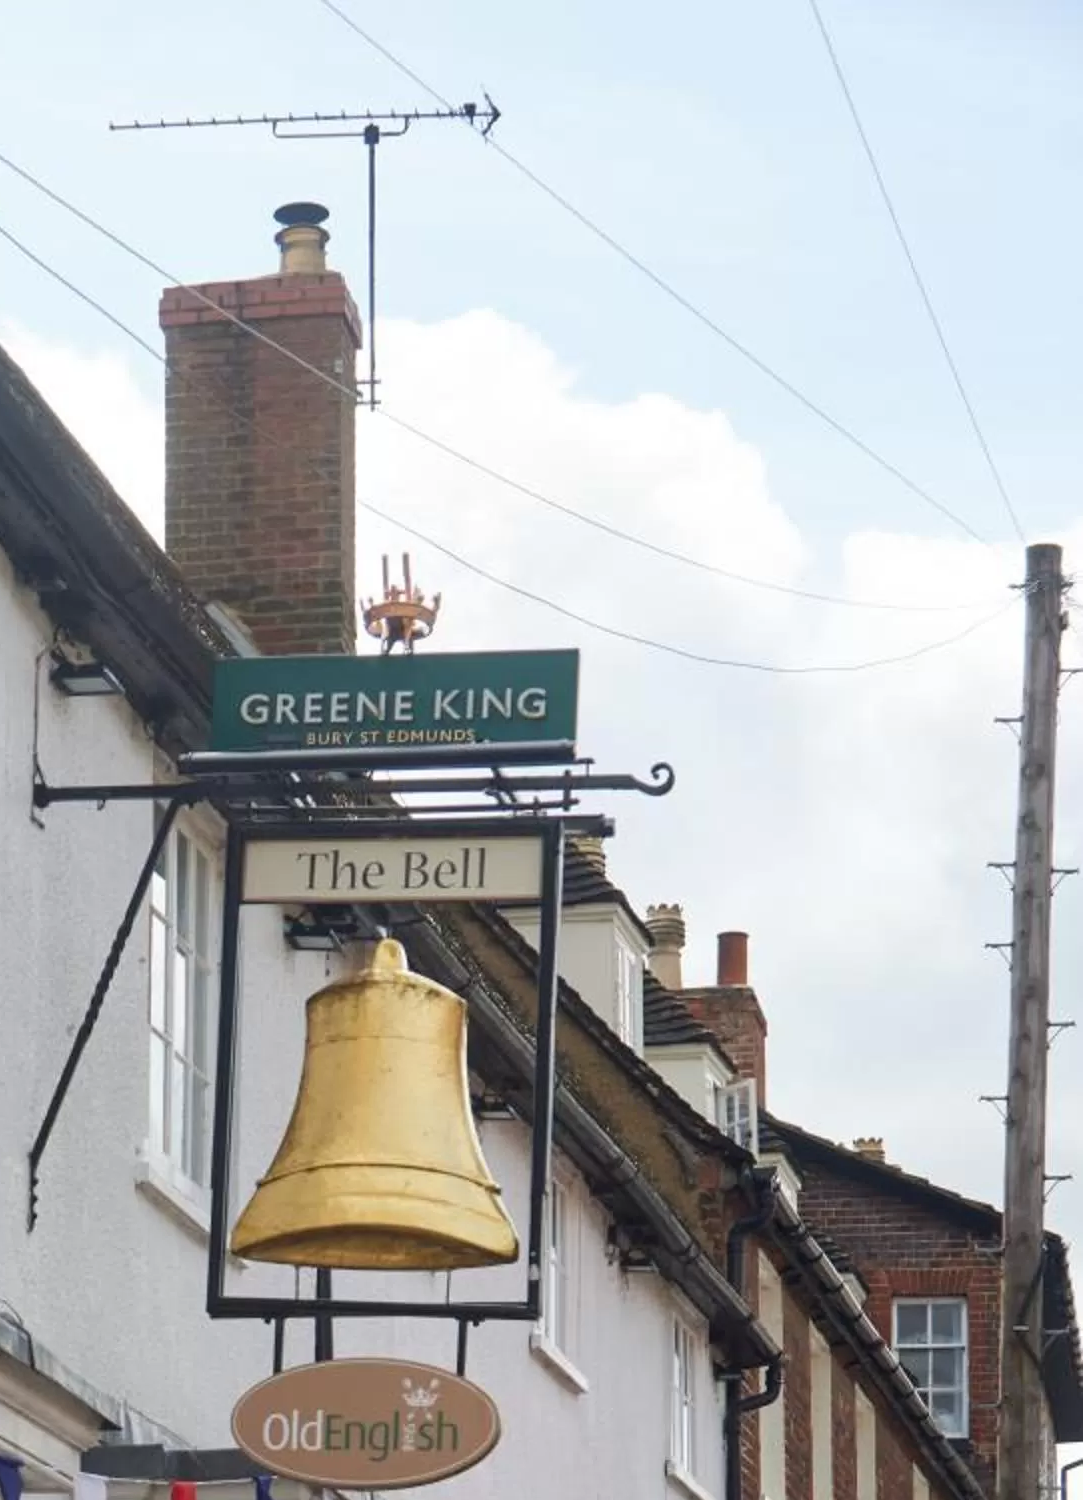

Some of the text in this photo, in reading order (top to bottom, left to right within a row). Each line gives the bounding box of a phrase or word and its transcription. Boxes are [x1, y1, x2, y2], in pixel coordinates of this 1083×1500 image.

[240, 687, 549, 724] GREENE KING
[306, 727, 477, 746] BURY ST EDMUNDS
[296, 846, 487, 891] The Bell
